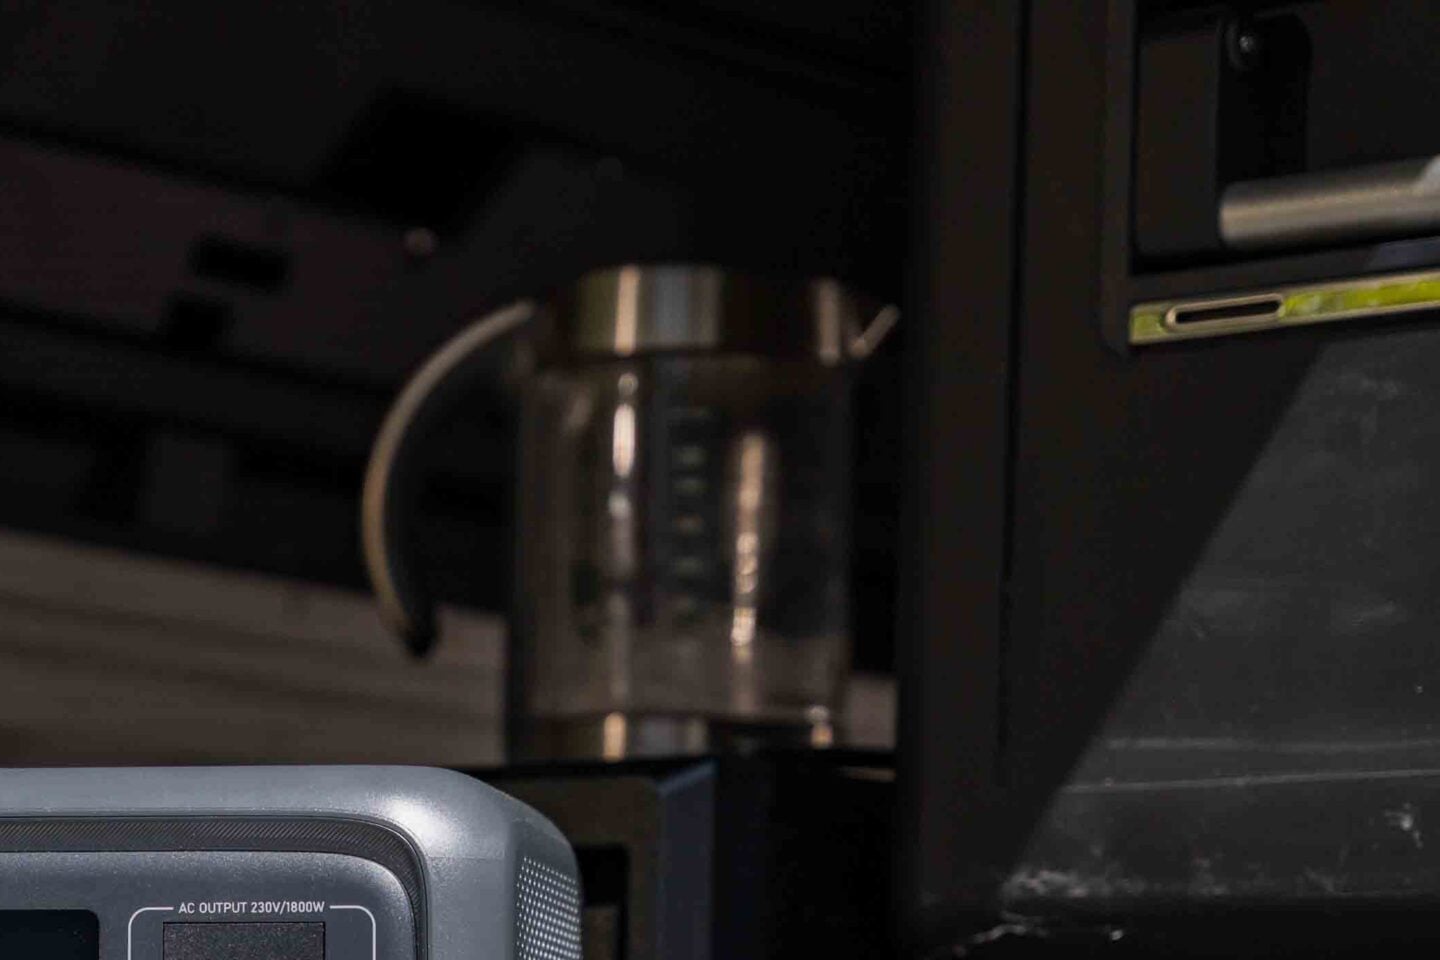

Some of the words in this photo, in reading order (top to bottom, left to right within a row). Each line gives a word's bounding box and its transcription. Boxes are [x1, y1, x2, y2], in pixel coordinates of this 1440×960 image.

[178, 902, 196, 915] AC
[199, 901, 248, 914] OUTPUT
[250, 900, 326, 915] 230V/1800W
